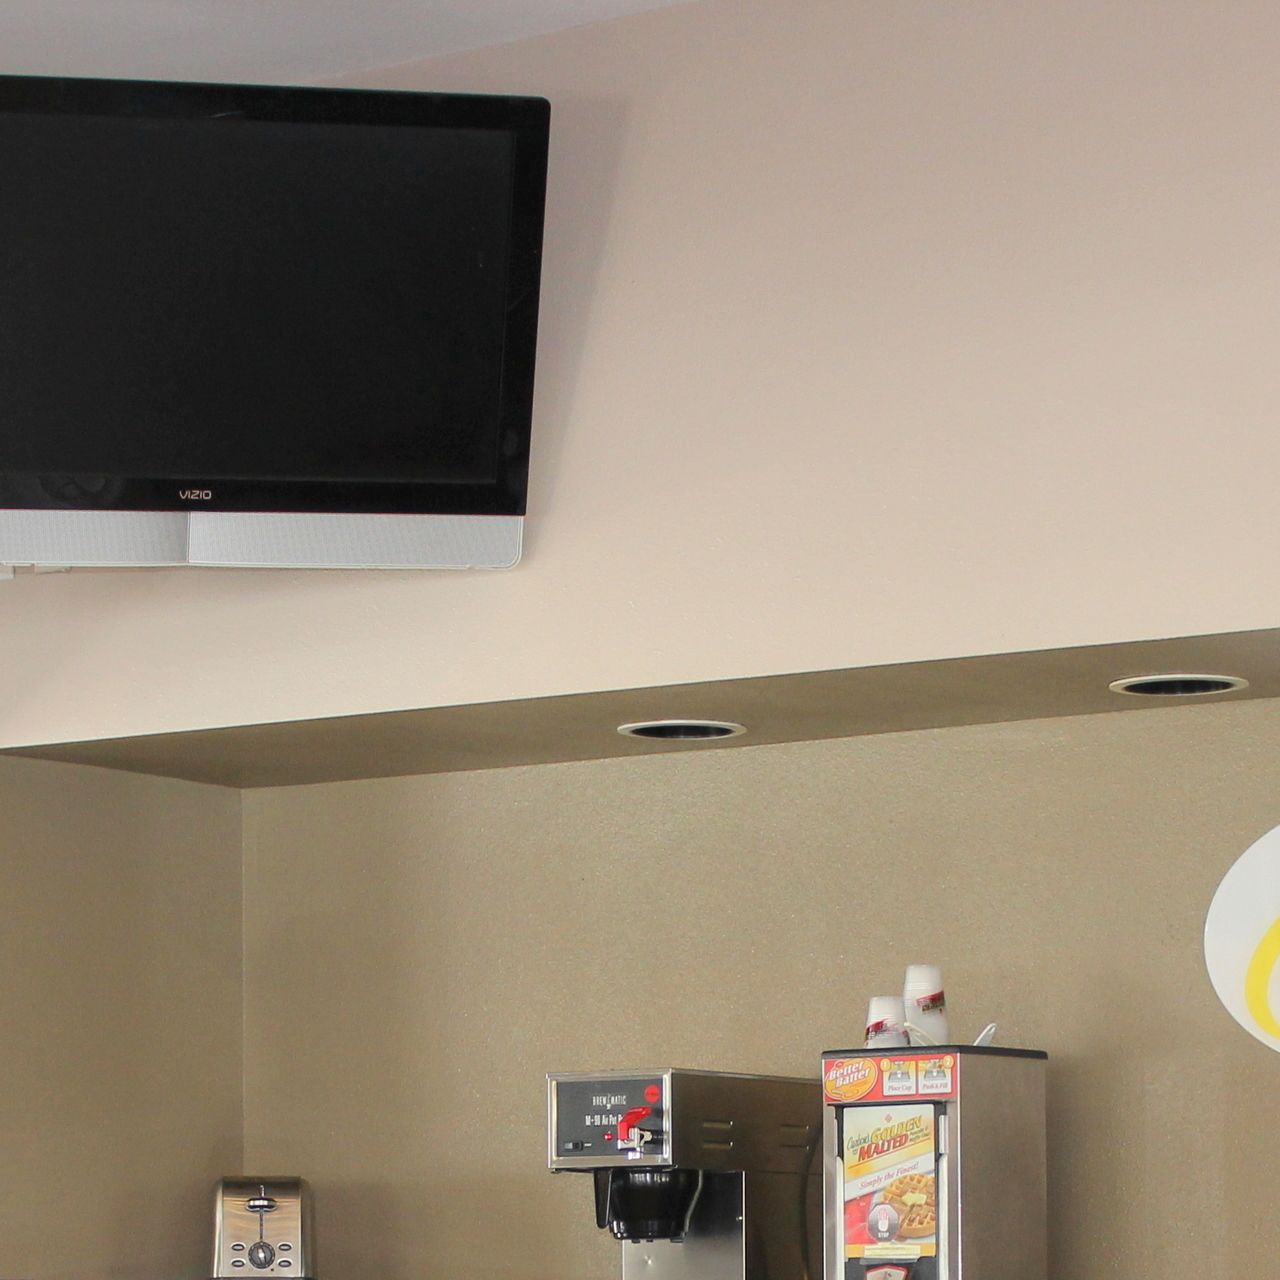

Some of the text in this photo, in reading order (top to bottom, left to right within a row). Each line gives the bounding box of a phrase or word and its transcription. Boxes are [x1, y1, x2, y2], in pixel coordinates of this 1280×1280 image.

[179, 490, 212, 500] VIZIO
[829, 1061, 865, 1081] Better
[835, 1068, 871, 1088] Batter
[871, 1115, 922, 1144] GOLDEN
[857, 1133, 909, 1162] MALTED
